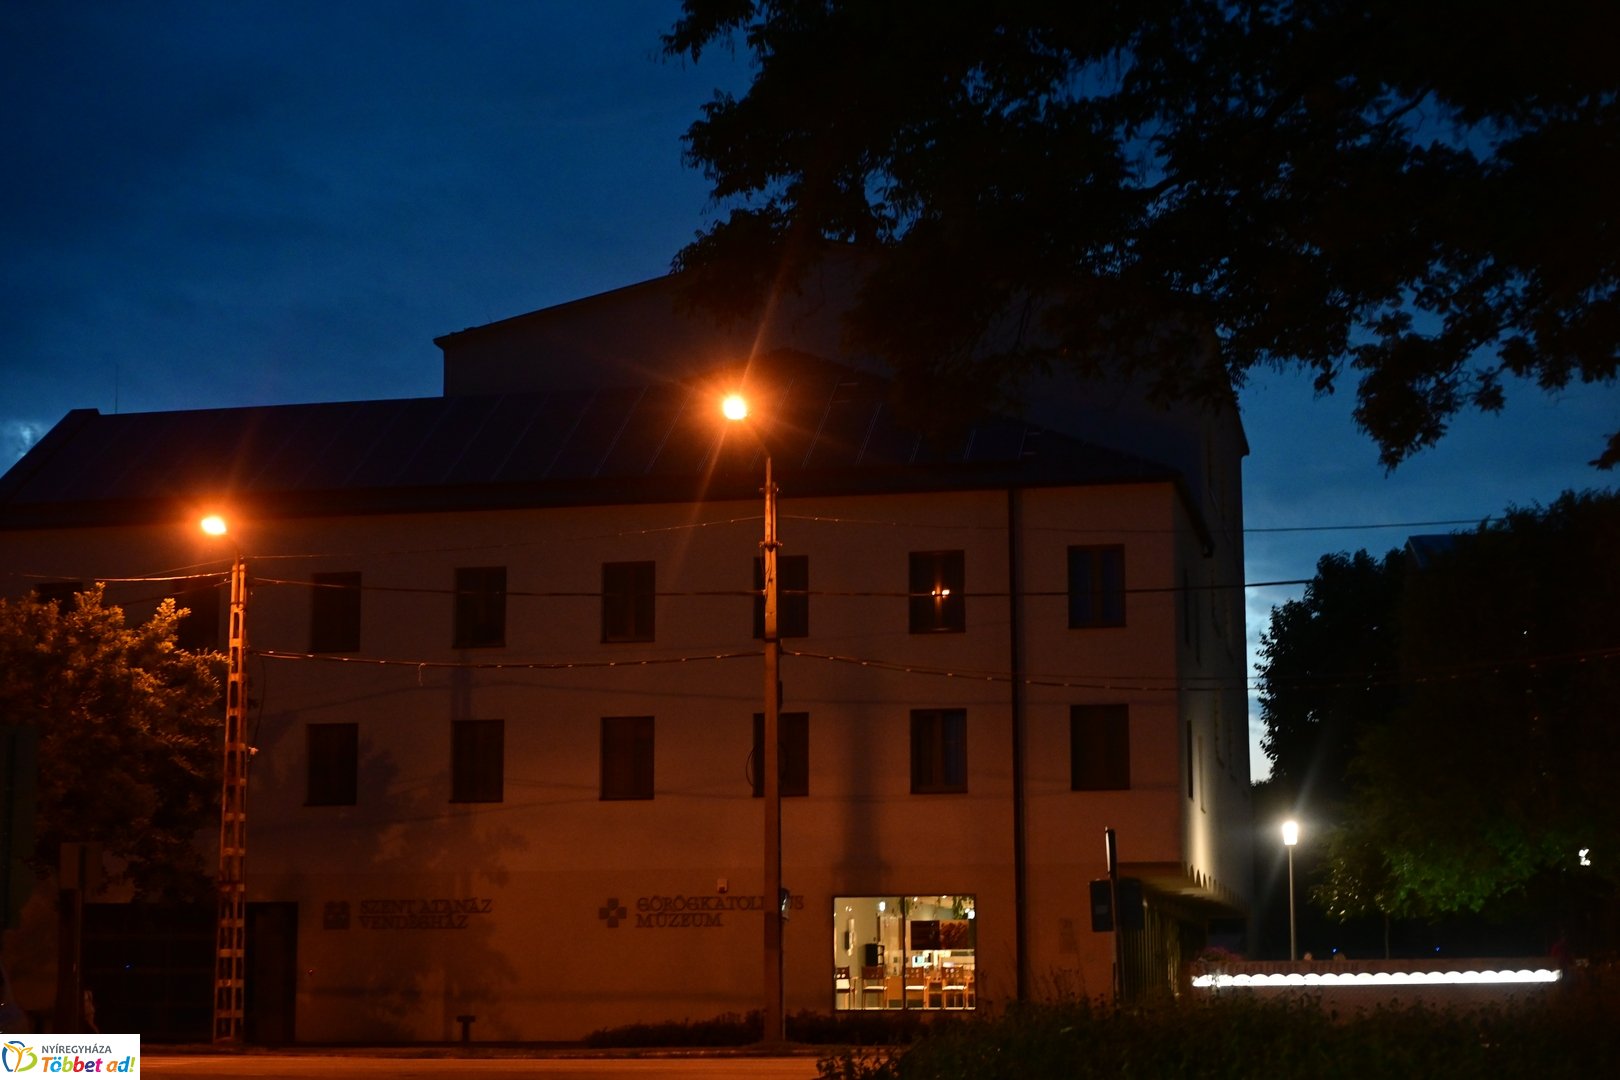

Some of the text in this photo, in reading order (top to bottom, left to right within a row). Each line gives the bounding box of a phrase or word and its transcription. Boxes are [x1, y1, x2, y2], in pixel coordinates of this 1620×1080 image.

[360, 899, 416, 914] SZENT
[636, 894, 804, 911] GÖRÖGKATOLIS
[635, 911, 724, 928] MÚZEUM
